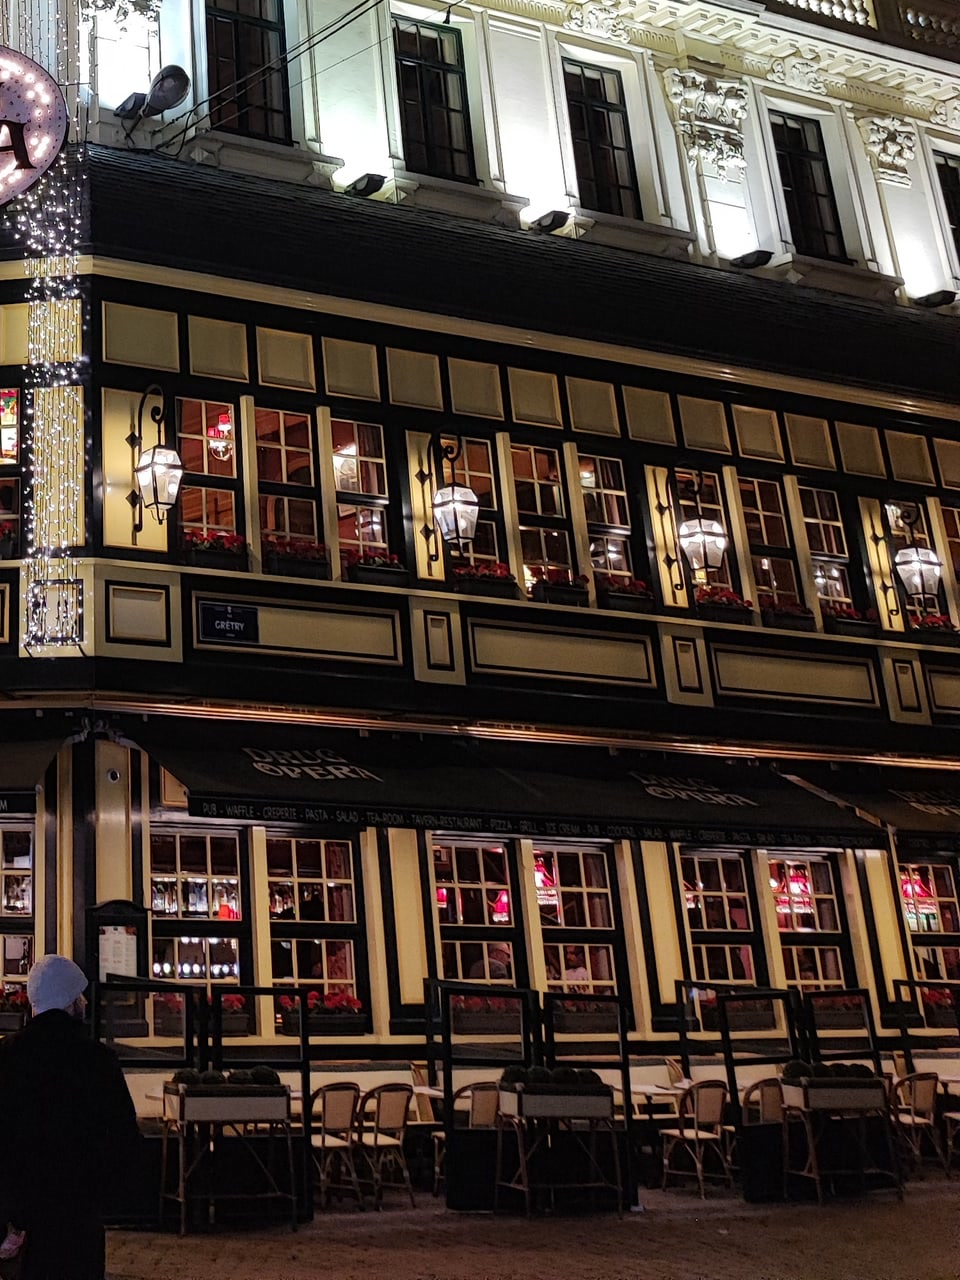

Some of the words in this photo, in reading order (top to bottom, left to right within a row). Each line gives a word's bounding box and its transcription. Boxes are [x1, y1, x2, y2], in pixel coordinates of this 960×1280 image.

[240, 746, 348, 764] DRUG
[252, 762, 384, 782] OPERA
[202, 803, 216, 816] PUB
[225, 804, 254, 818] WAFFLE
[305, 808, 328, 821] PASTA
[336, 810, 359, 823] SALAD
